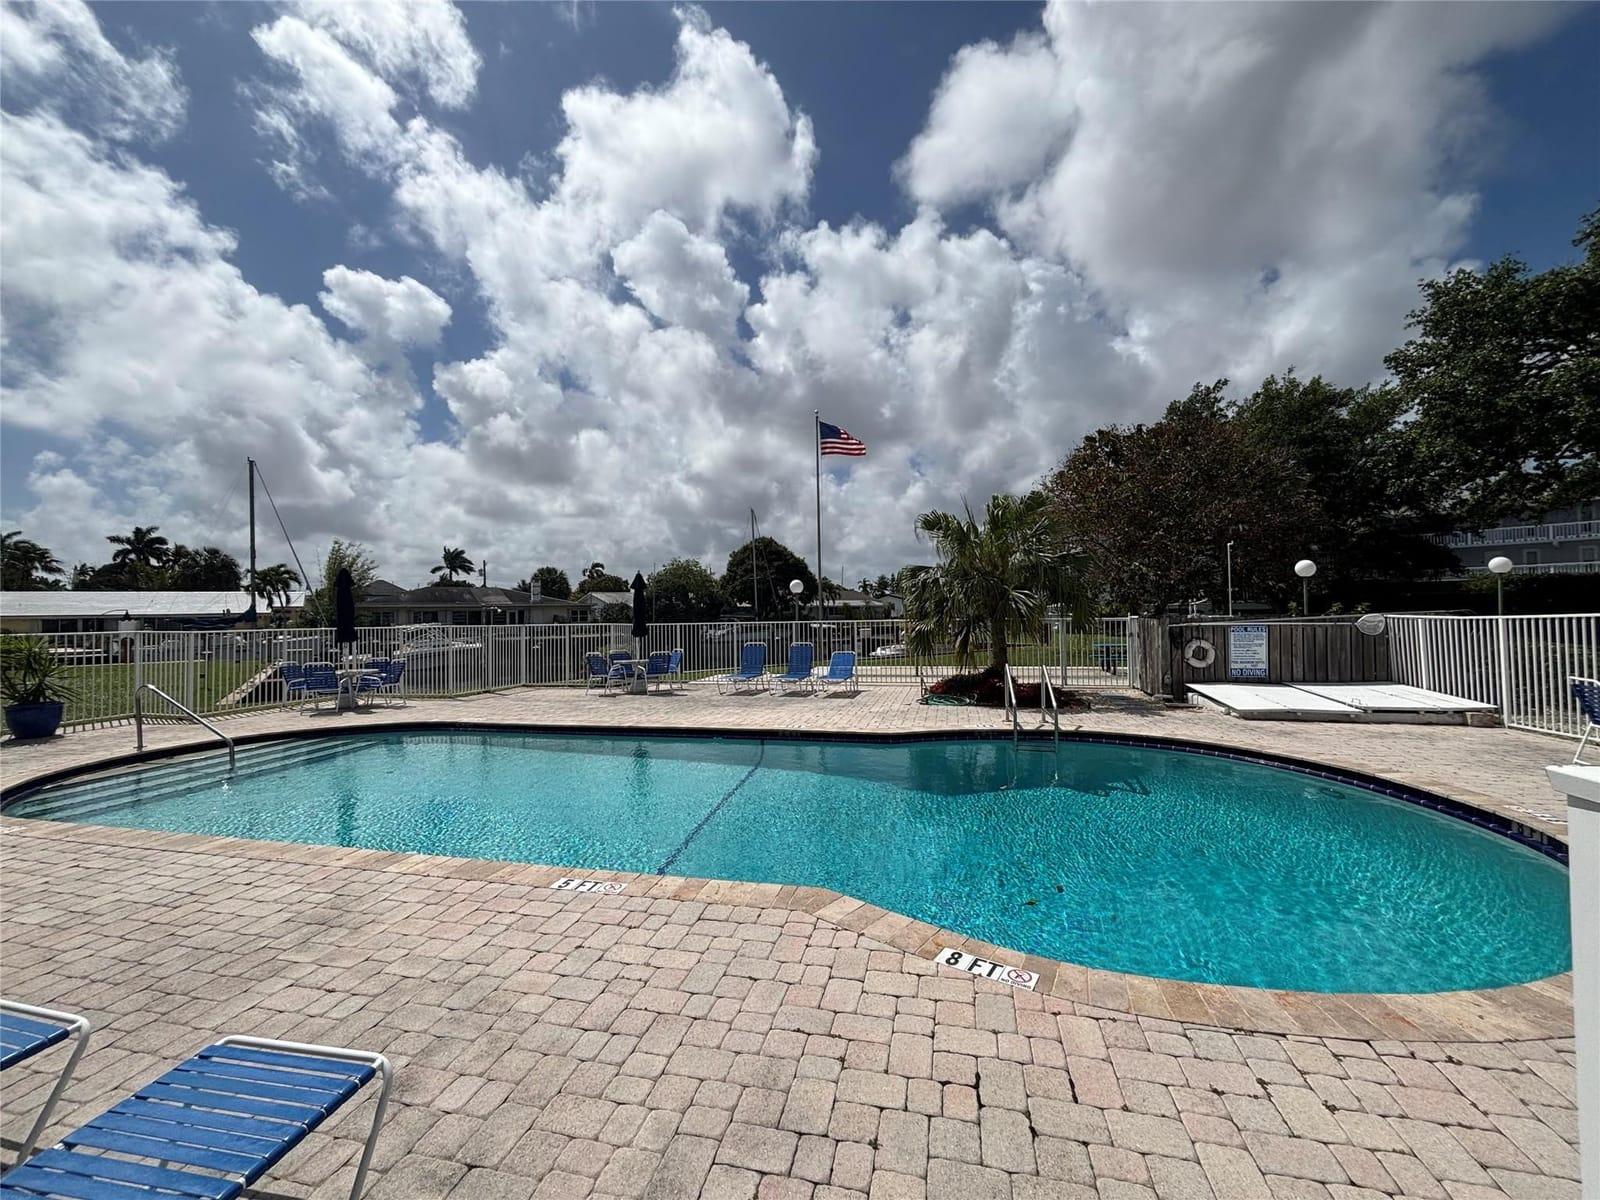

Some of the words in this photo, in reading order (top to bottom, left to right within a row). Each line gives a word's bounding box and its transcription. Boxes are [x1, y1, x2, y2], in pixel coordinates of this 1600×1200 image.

[558, 879, 574, 889] 5
[574, 880, 603, 891] FT
[945, 951, 963, 965] 8
[967, 957, 1005, 978] FT
